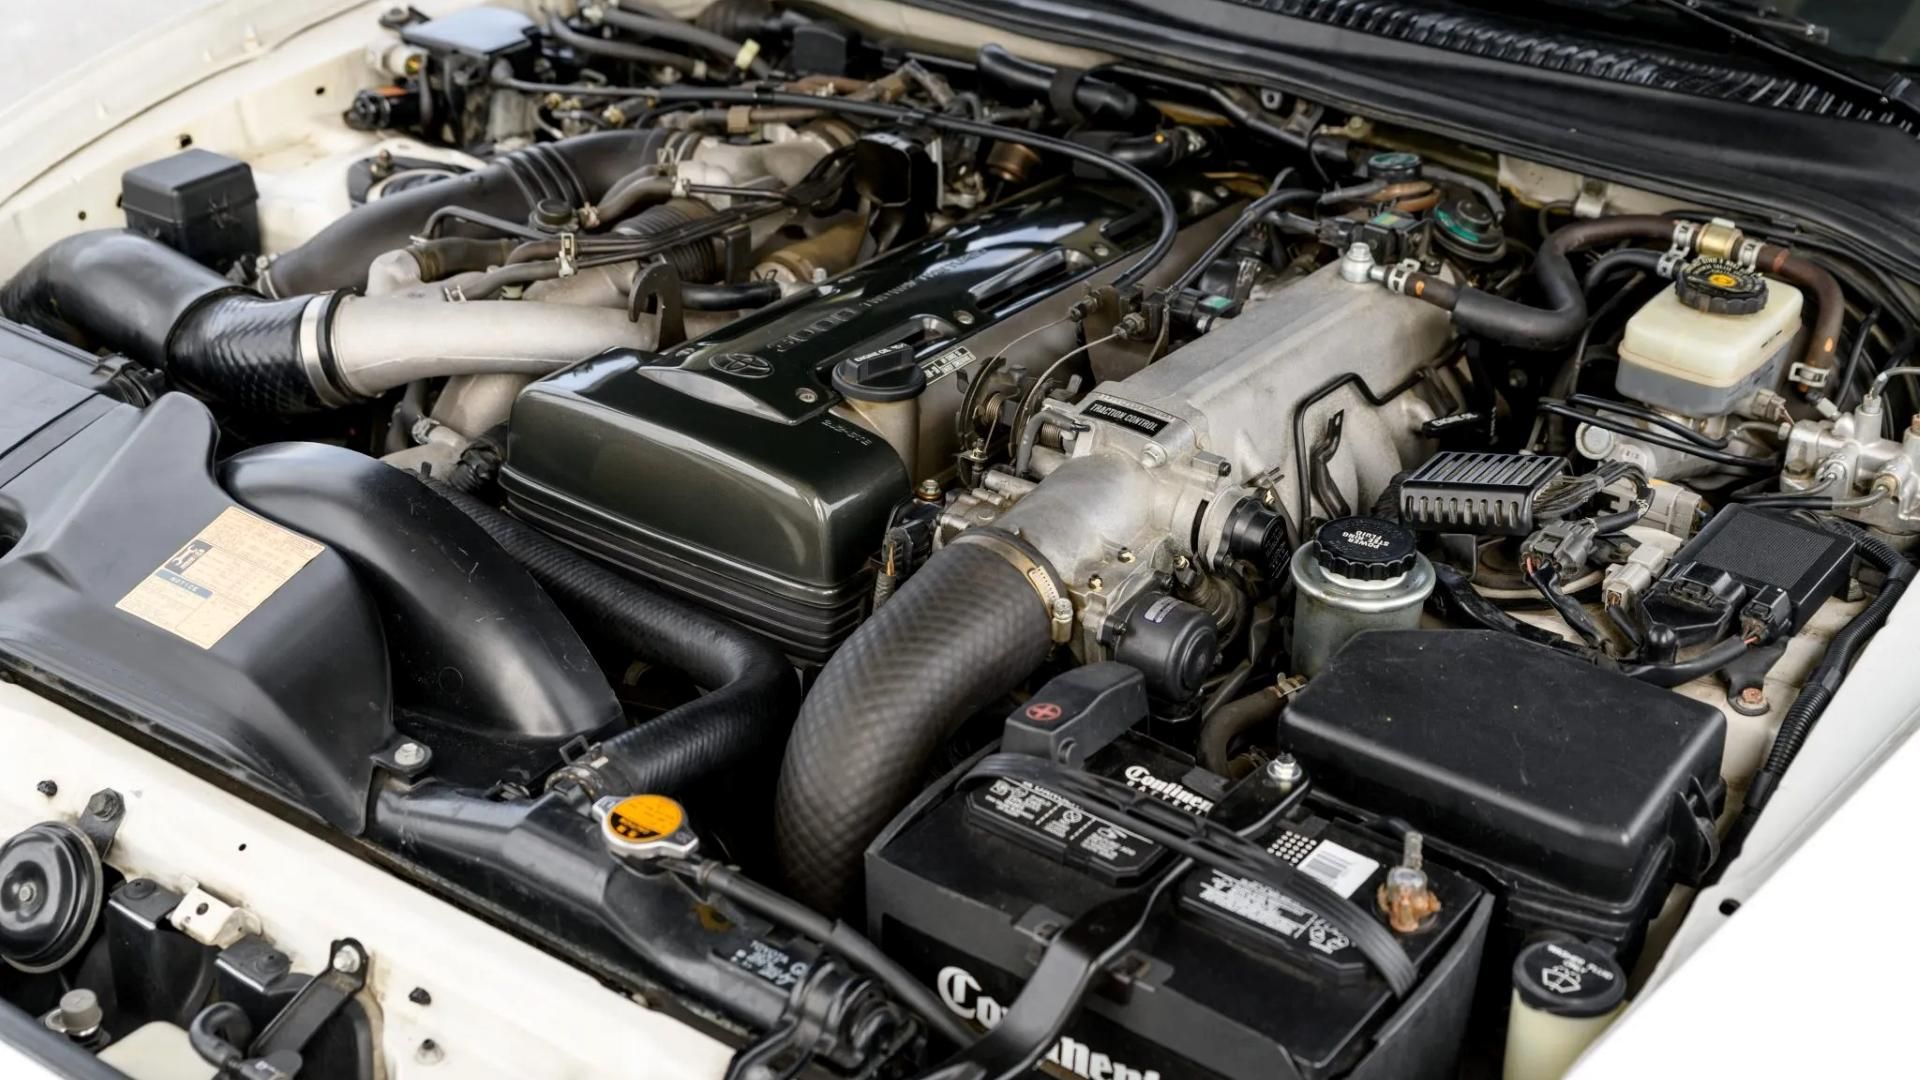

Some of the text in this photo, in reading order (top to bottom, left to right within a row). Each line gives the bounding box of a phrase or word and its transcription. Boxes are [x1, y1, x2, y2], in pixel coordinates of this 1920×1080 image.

[1090, 403, 1126, 421] TRACTION
[1123, 413, 1158, 432] CONTROL
[1347, 537, 1380, 549] POWER
[1355, 530, 1382, 540] FLUID
[1125, 765, 1214, 813] Continen
